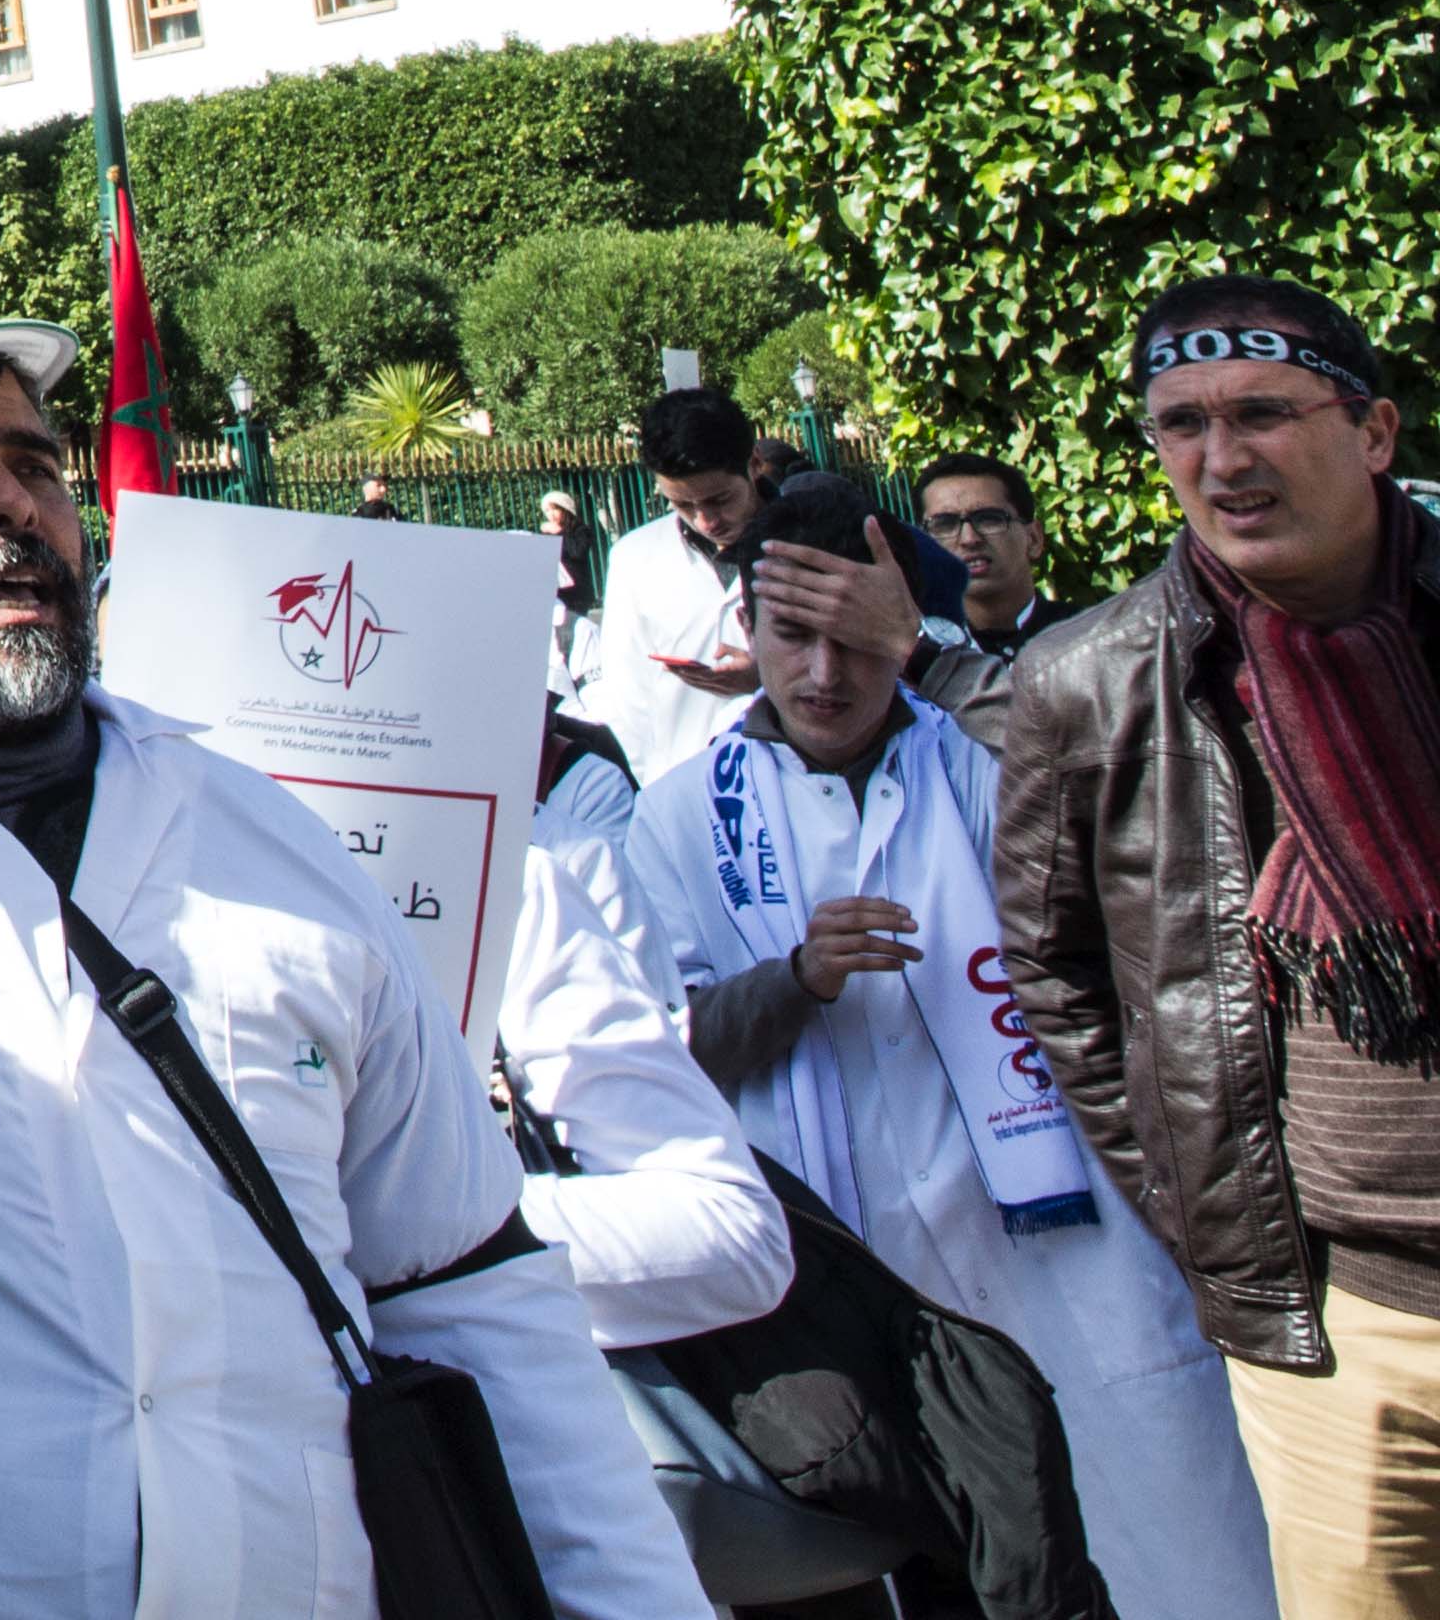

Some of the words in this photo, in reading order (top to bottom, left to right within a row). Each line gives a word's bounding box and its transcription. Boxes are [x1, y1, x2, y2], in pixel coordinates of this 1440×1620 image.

[1146, 328, 1290, 375] 509
[225, 715, 297, 734] Commission
[299, 724, 354, 741] Nationale
[356, 731, 376, 743] des
[263, 738, 278, 748] en
[340, 747, 354, 757] au
[356, 746, 392, 760] Maroc
